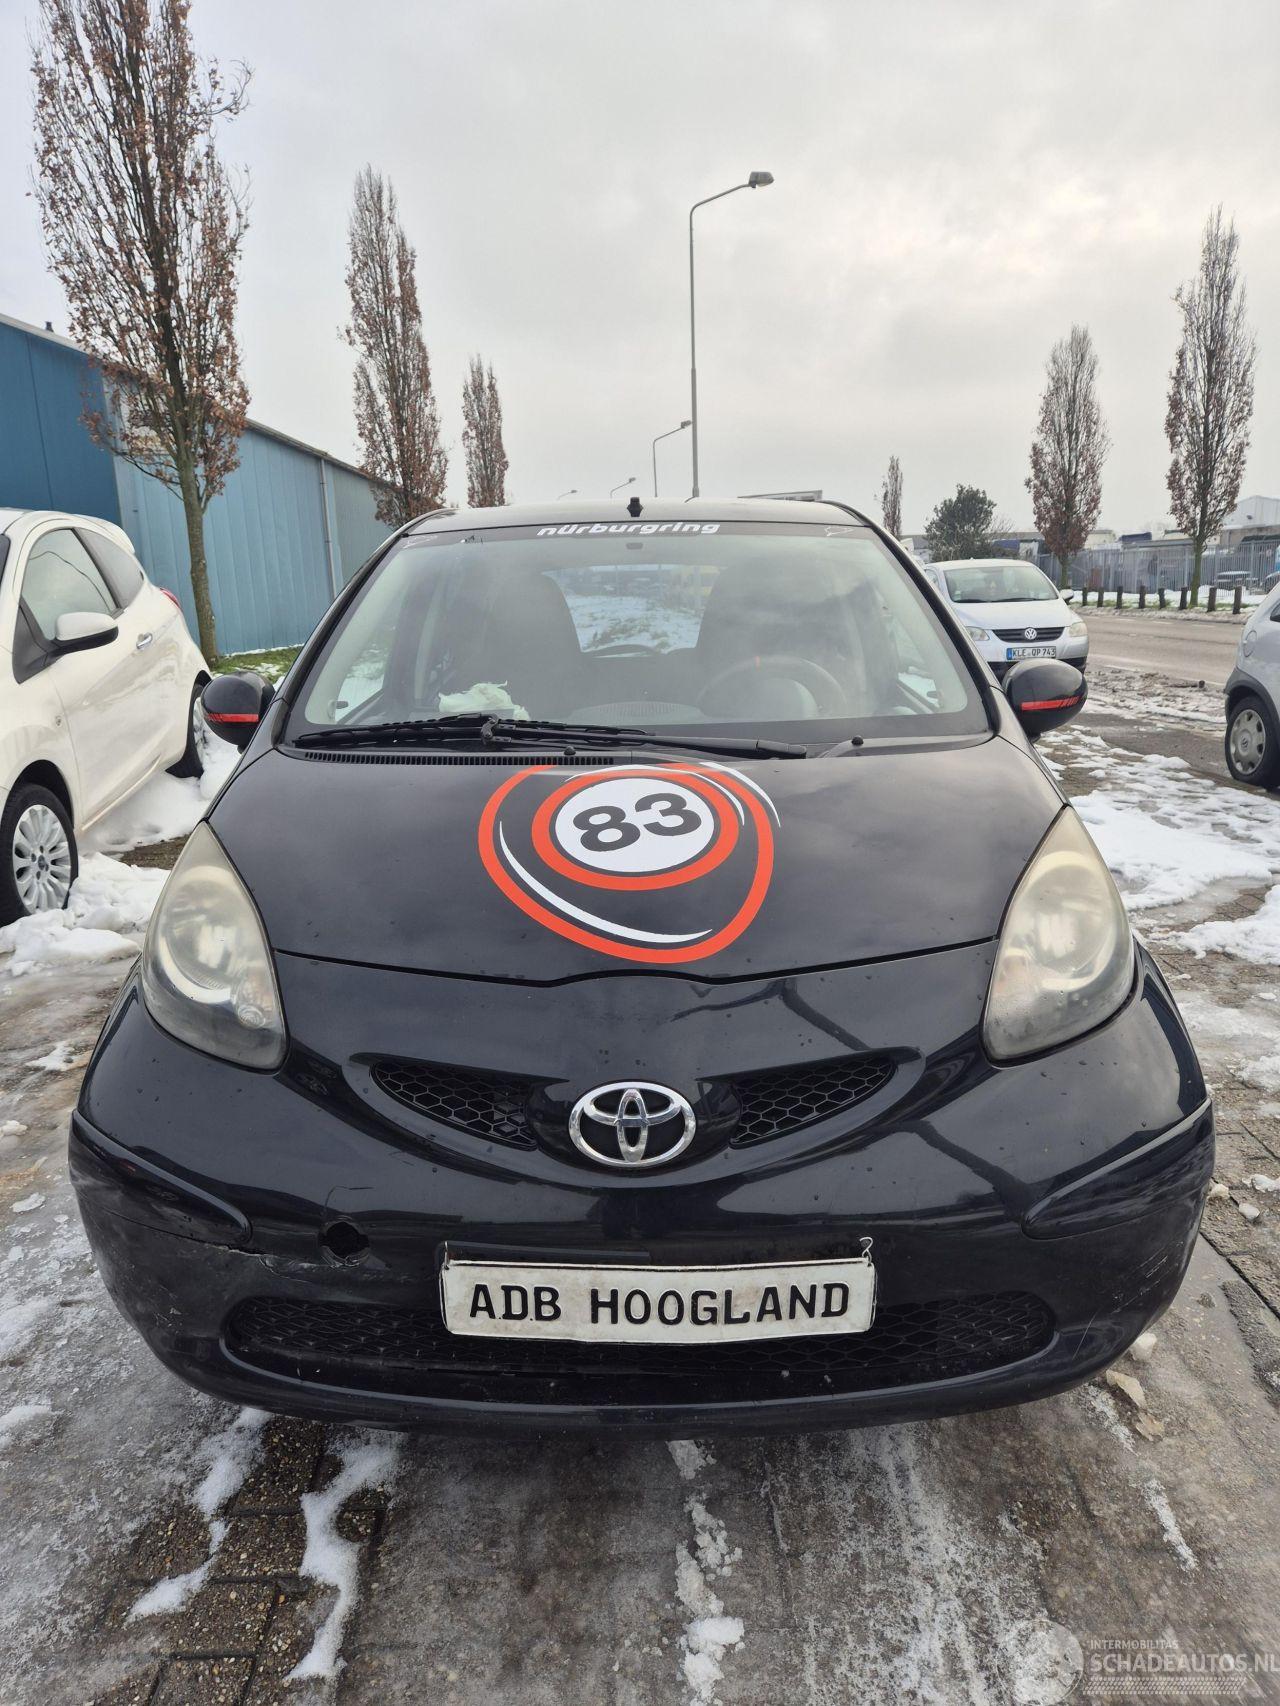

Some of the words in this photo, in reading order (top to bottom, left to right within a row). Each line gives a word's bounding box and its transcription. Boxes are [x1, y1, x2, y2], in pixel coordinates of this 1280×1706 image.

[536, 522, 721, 536] nürburgring
[1012, 648, 1026, 657] KLE
[572, 792, 702, 852] 83
[590, 1282, 851, 1325] HOOGLAND
